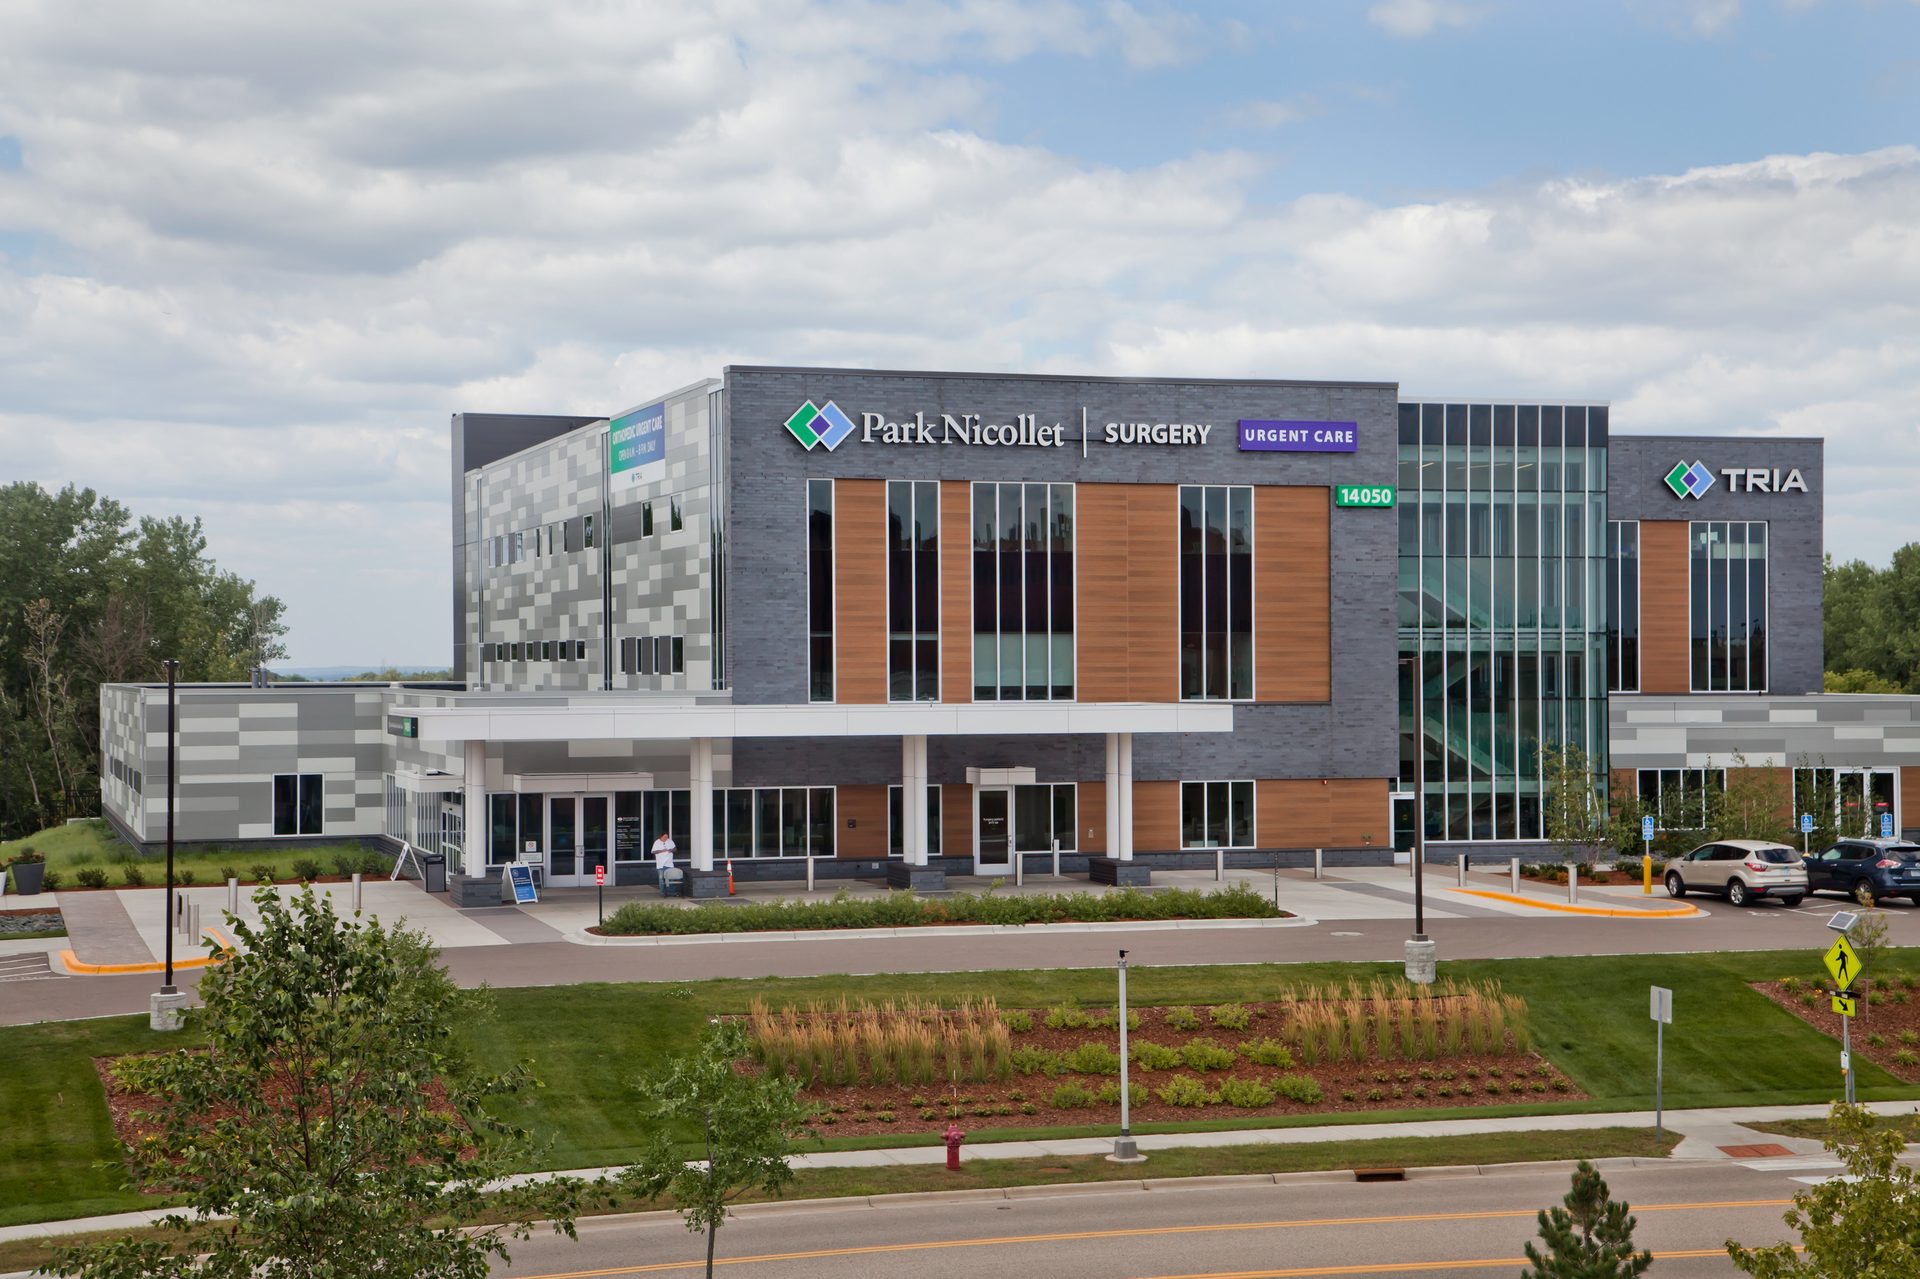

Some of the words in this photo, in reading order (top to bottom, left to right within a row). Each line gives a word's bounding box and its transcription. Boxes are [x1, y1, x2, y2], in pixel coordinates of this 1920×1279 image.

[861, 411, 937, 444] Park
[941, 413, 1065, 447] Nicollet
[1105, 422, 1212, 445] SURGERY
[1245, 429, 1309, 443] URGENT
[1314, 429, 1353, 444] CARE
[1721, 468, 1809, 493] TRIA
[1341, 488, 1392, 504] 14050
